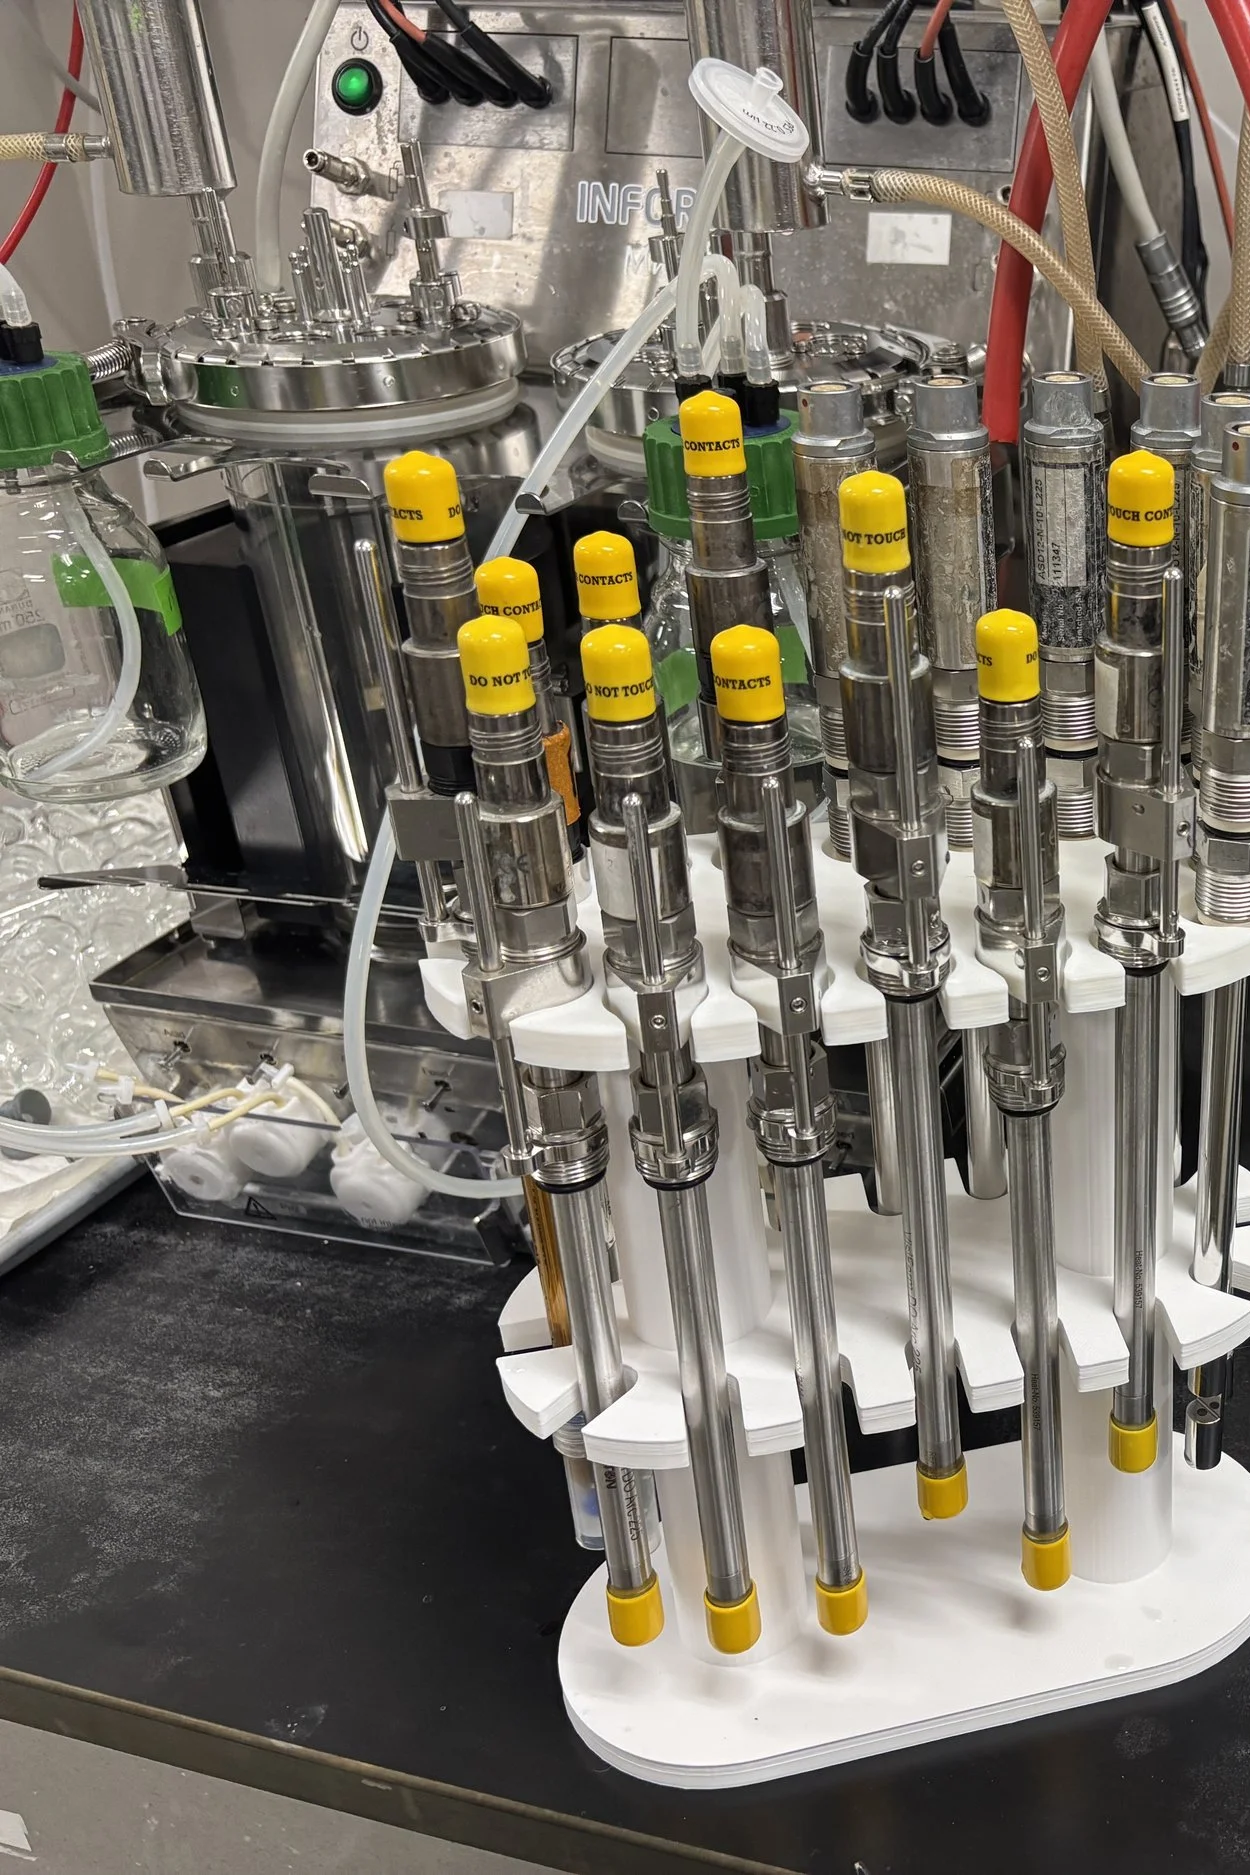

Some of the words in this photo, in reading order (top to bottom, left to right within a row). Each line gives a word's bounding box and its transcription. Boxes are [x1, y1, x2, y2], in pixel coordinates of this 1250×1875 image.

[576, 181, 698, 229] INFOR
[684, 437, 740, 452] CONTACTS
[391, 507, 424, 521] ACTS
[866, 527, 906, 545] TOUCH
[578, 571, 633, 586] CONTACTS
[469, 674, 488, 687] DO
[491, 673, 521, 687] NOT
[595, 683, 620, 699] NOT
[621, 677, 654, 696] TOUC
